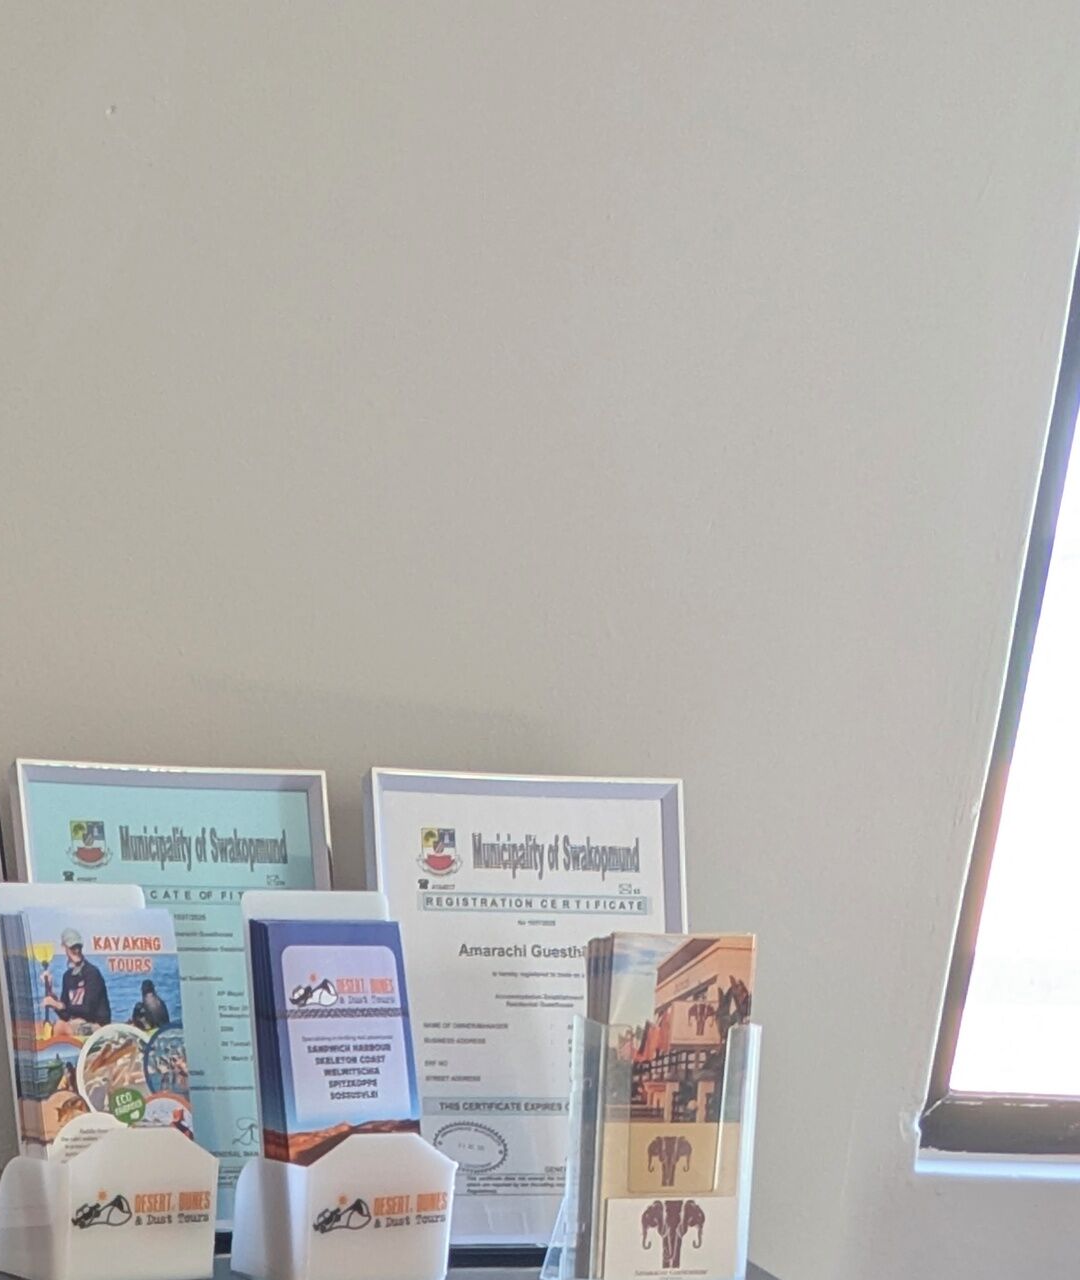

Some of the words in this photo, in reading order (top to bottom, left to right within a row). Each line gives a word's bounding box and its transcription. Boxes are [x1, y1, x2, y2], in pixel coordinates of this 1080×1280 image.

[119, 825, 193, 872] Municipality
[196, 828, 208, 863] of
[210, 827, 289, 873] Swakopmund
[471, 832, 545, 880] Municipality
[547, 834, 560, 872] of
[562, 834, 641, 881] Swakopmund
[425, 896, 533, 910] REGISTRATION
[540, 898, 644, 912] CERTIFICATE
[93, 936, 162, 951] KAYAKING
[458, 943, 527, 958] Amarachi
[108, 957, 152, 973] TOURS
[307, 1044, 351, 1054] SANDWICH
[352, 1043, 392, 1053] HARBOUR
[315, 1056, 358, 1066] SKELETON
[359, 1055, 386, 1065] COAST
[439, 1102, 460, 1111] THIS
[462, 1102, 521, 1111] CERTIFICATE
[524, 1103, 562, 1112] EXPIRES
[134, 1193, 171, 1213] DESERT
[146, 1214, 173, 1226] Dust
[177, 1212, 210, 1224] Tours
[385, 1217, 411, 1228] Dust
[415, 1214, 447, 1226] Tours
